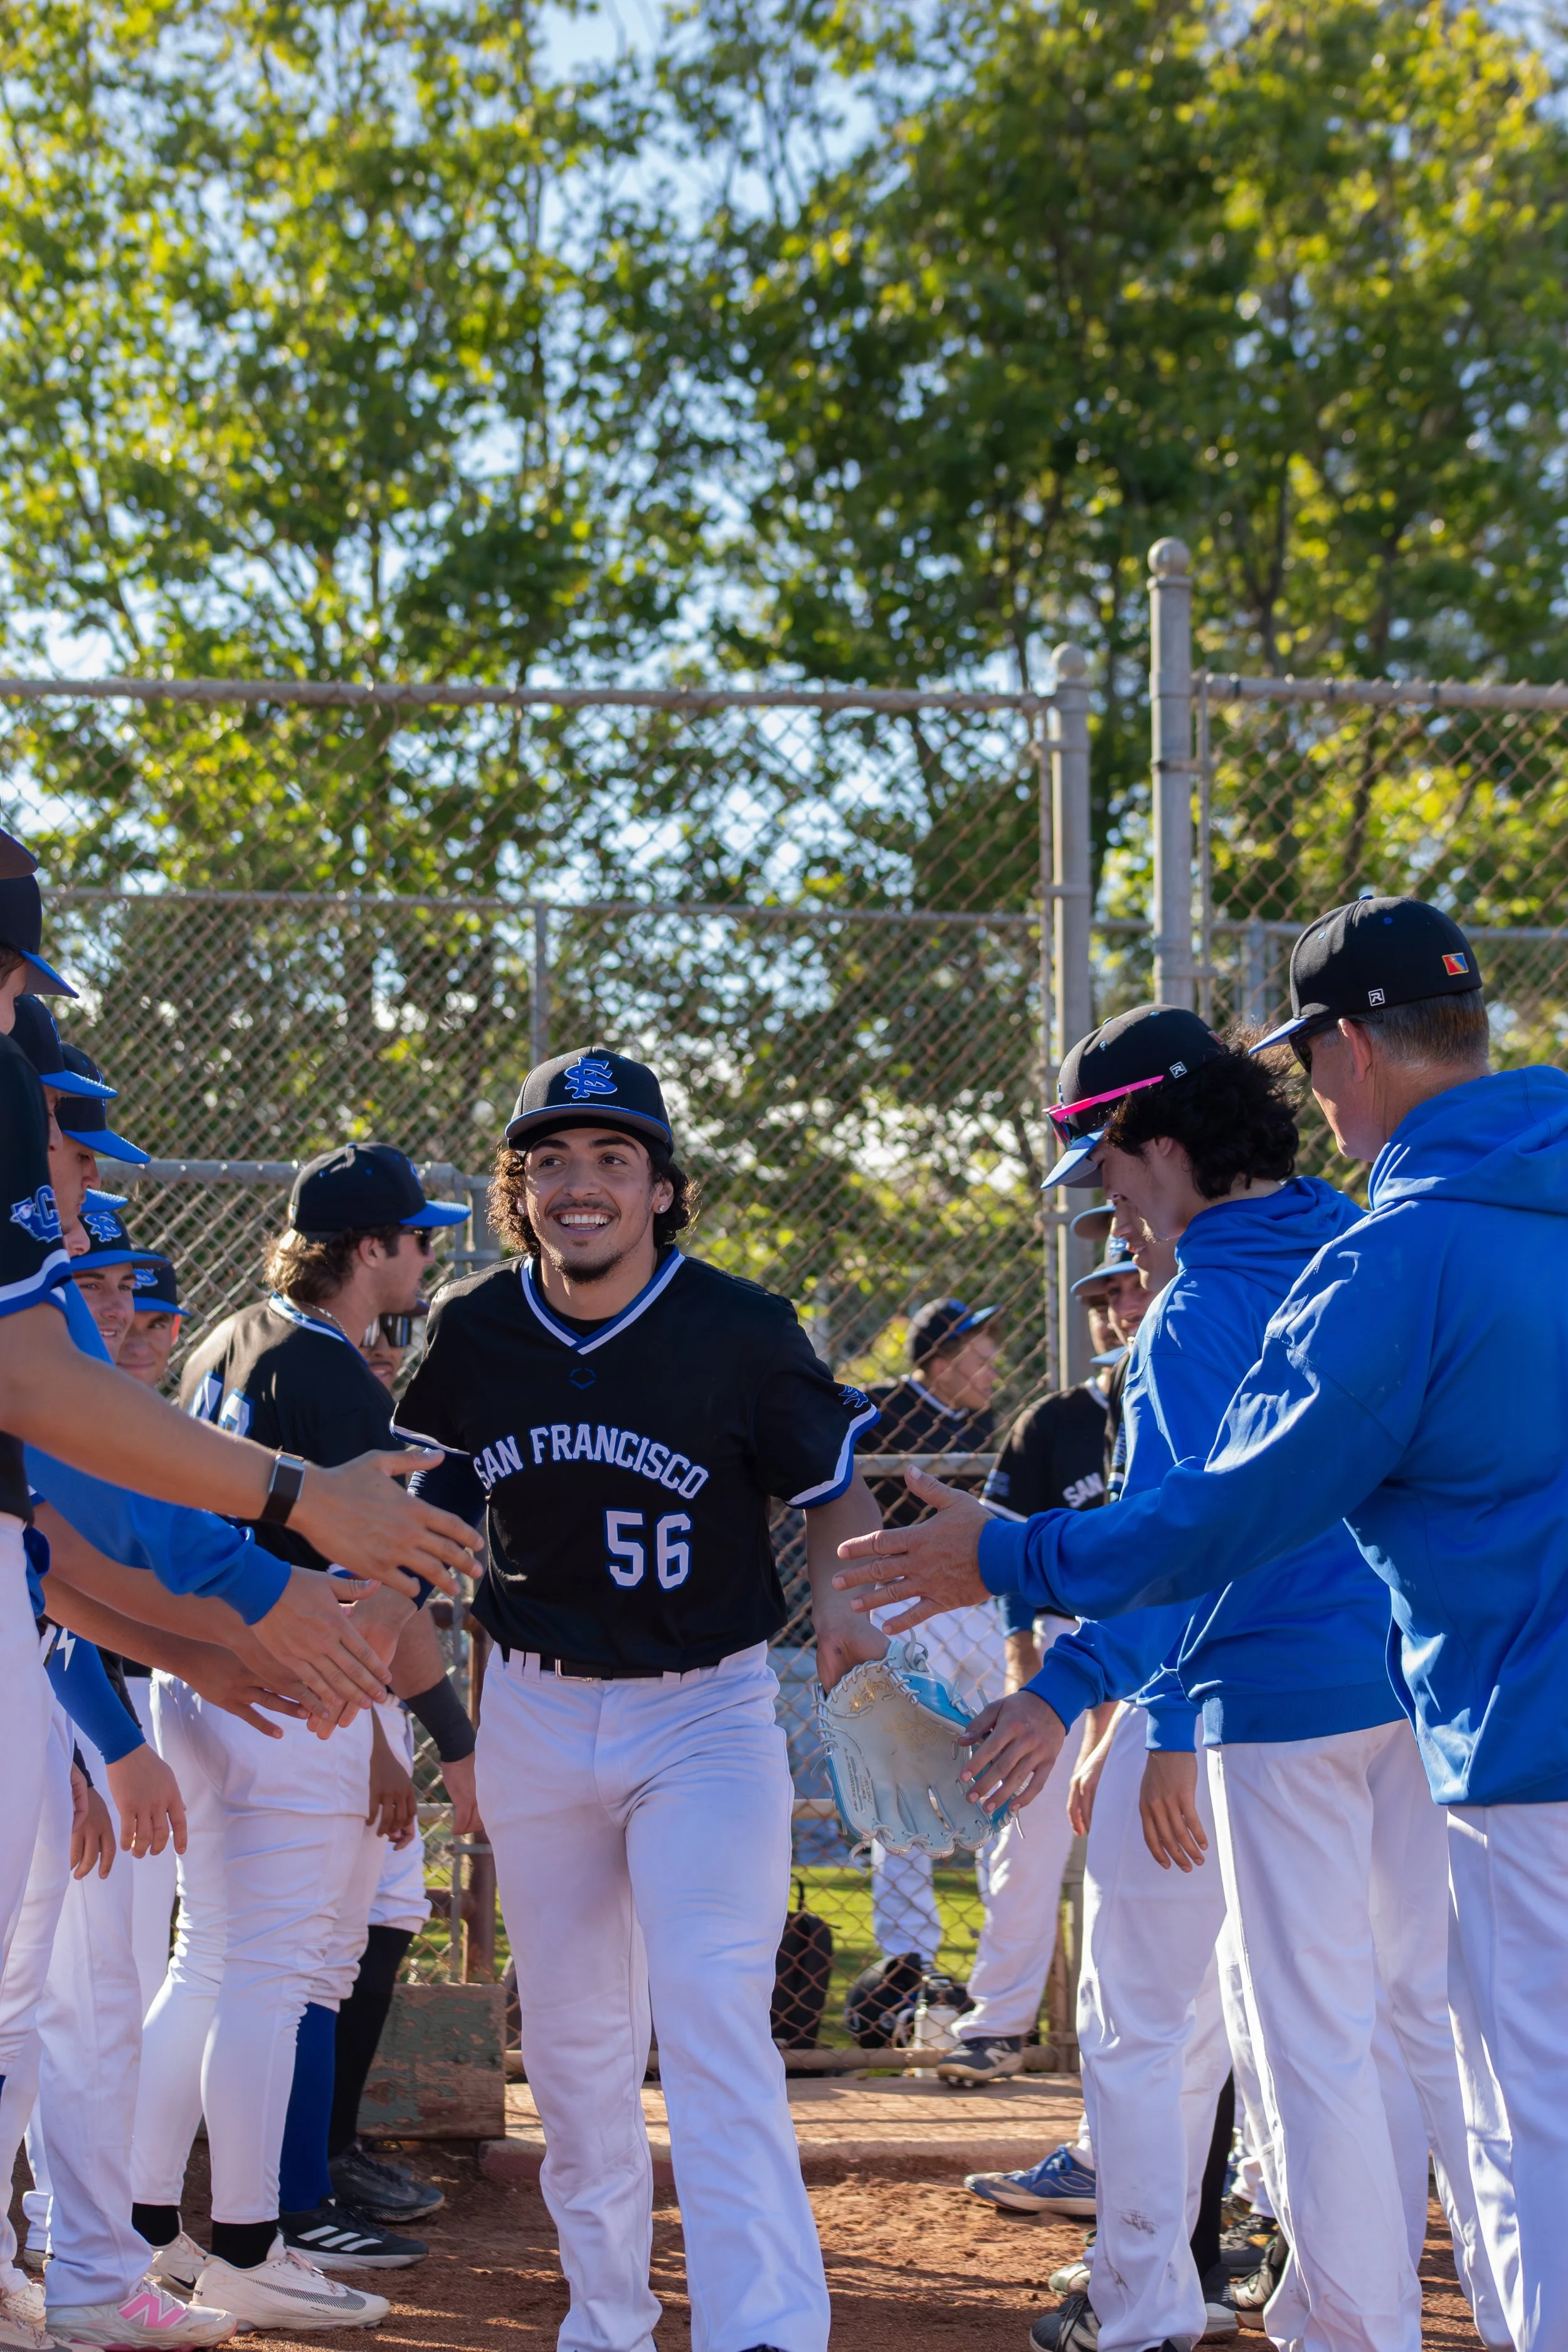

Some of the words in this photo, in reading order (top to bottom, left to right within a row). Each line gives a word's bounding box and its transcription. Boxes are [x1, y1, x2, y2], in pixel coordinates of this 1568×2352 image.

[472, 1434, 524, 1491] SAN
[529, 1422, 711, 1500] FRANCISCO
[1062, 1472, 1104, 1508] SAN
[604, 1508, 692, 1591] 56
